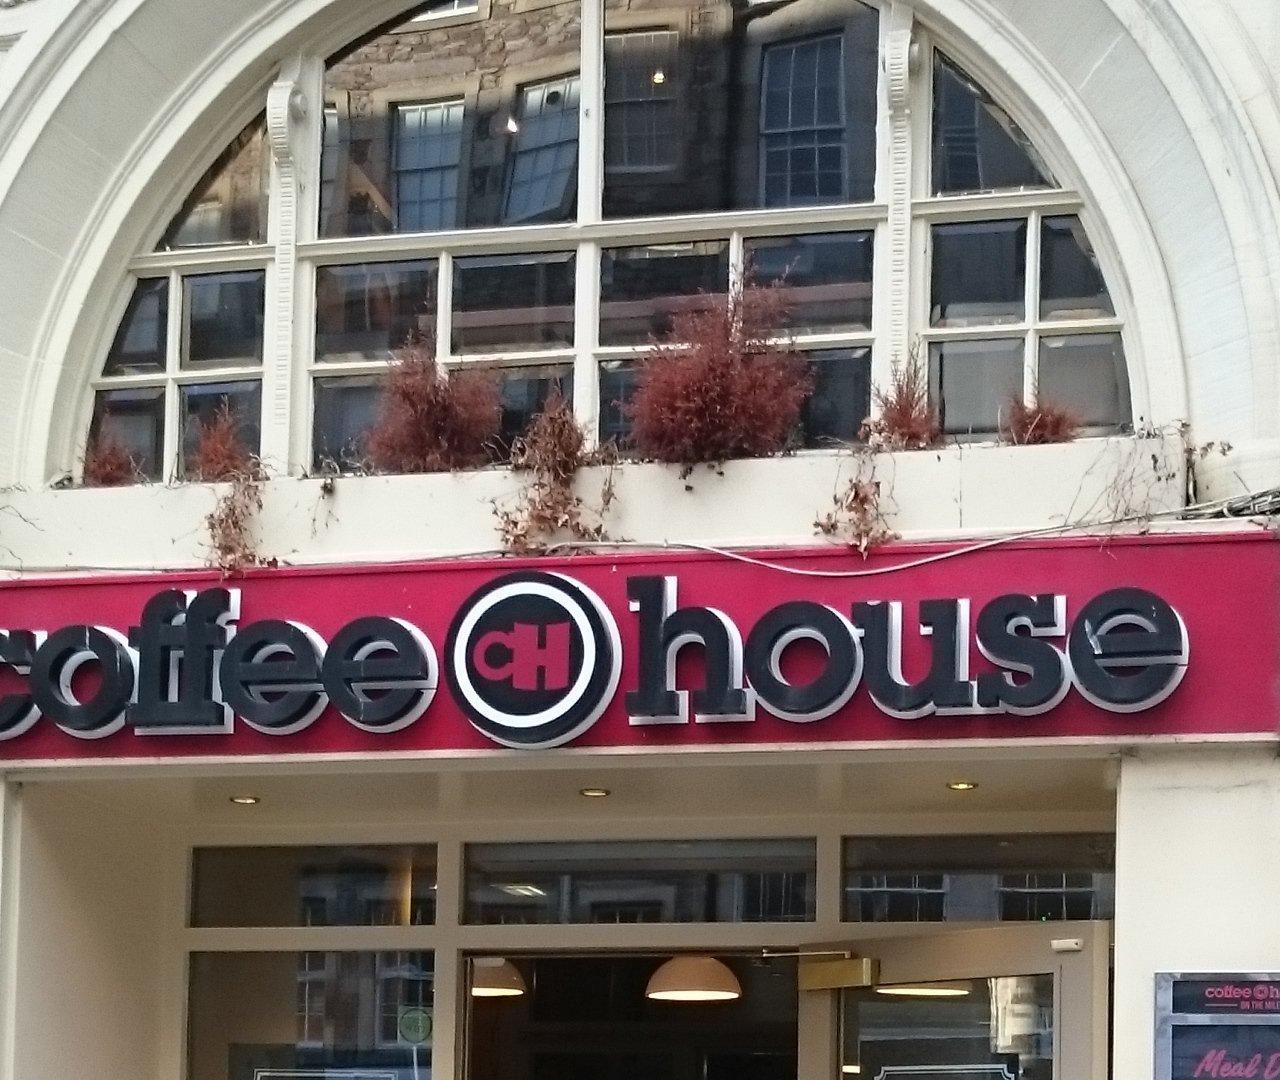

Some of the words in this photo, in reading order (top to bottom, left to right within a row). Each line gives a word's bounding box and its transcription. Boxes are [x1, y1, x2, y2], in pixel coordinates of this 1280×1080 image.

[626, 575, 1190, 726] house
[1205, 985, 1252, 998] coffee
[1251, 1001, 1263, 1009] THE
[1193, 1049, 1262, 1079] Meal
